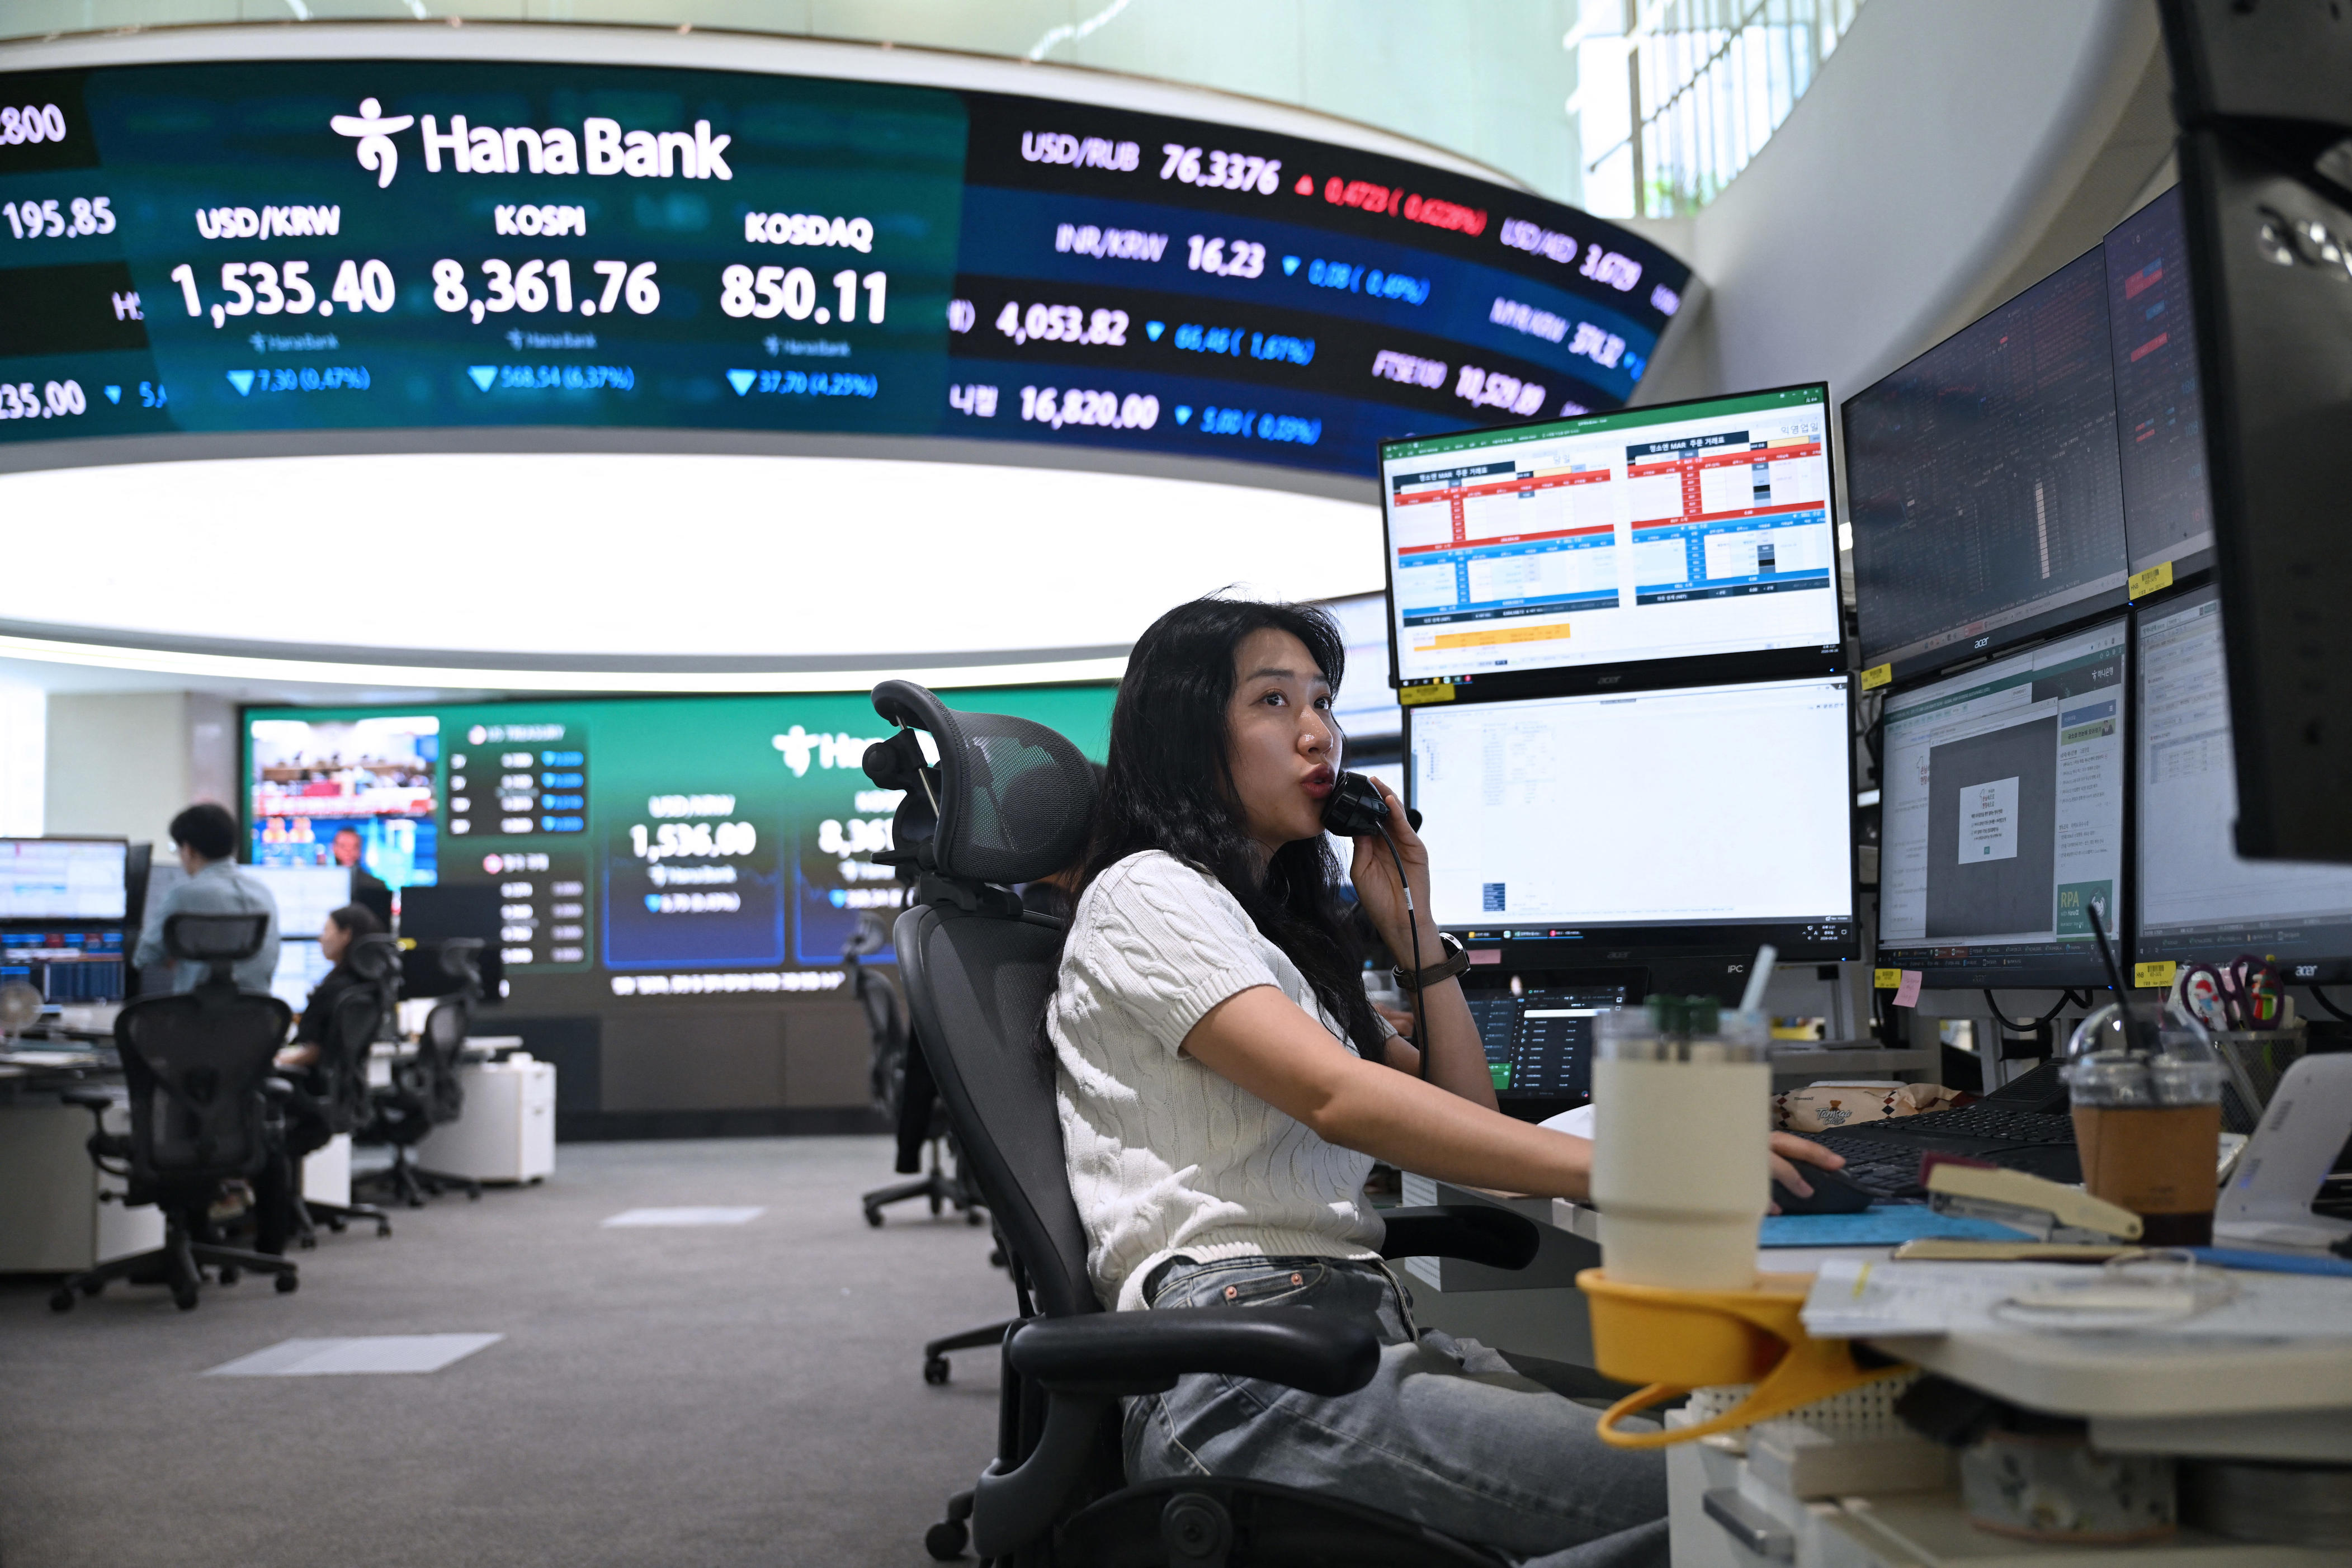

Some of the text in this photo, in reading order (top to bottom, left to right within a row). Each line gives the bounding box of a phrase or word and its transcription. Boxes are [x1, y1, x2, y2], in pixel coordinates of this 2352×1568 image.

[1021, 131, 1140, 171] USD/RUB
[1160, 144, 1281, 195] 76.3376
[196, 205, 340, 240] USD/KRW
[494, 205, 586, 237] KOSPI
[745, 212, 873, 253] KOSDAQ
[1188, 234, 1265, 278] 16.23
[171, 259, 395, 328] 1,535.40
[432, 259, 660, 324] 8,361.76
[721, 265, 886, 324] 850.11
[996, 299, 1129, 346] 4,053.82
[1021, 385, 1159, 430] 16,820.00
[1670, 441, 1687, 450] MAR
[1438, 471, 1453, 479] MAR
[1975, 637, 1989, 649] acer
[1598, 676, 1621, 685] acer
[2098, 667, 2113, 678] 하나은행
[2061, 891, 2080, 909] RPA
[1607, 951, 1631, 960] acer
[1728, 965, 1744, 973] IPC
[2295, 965, 2318, 977] acer
